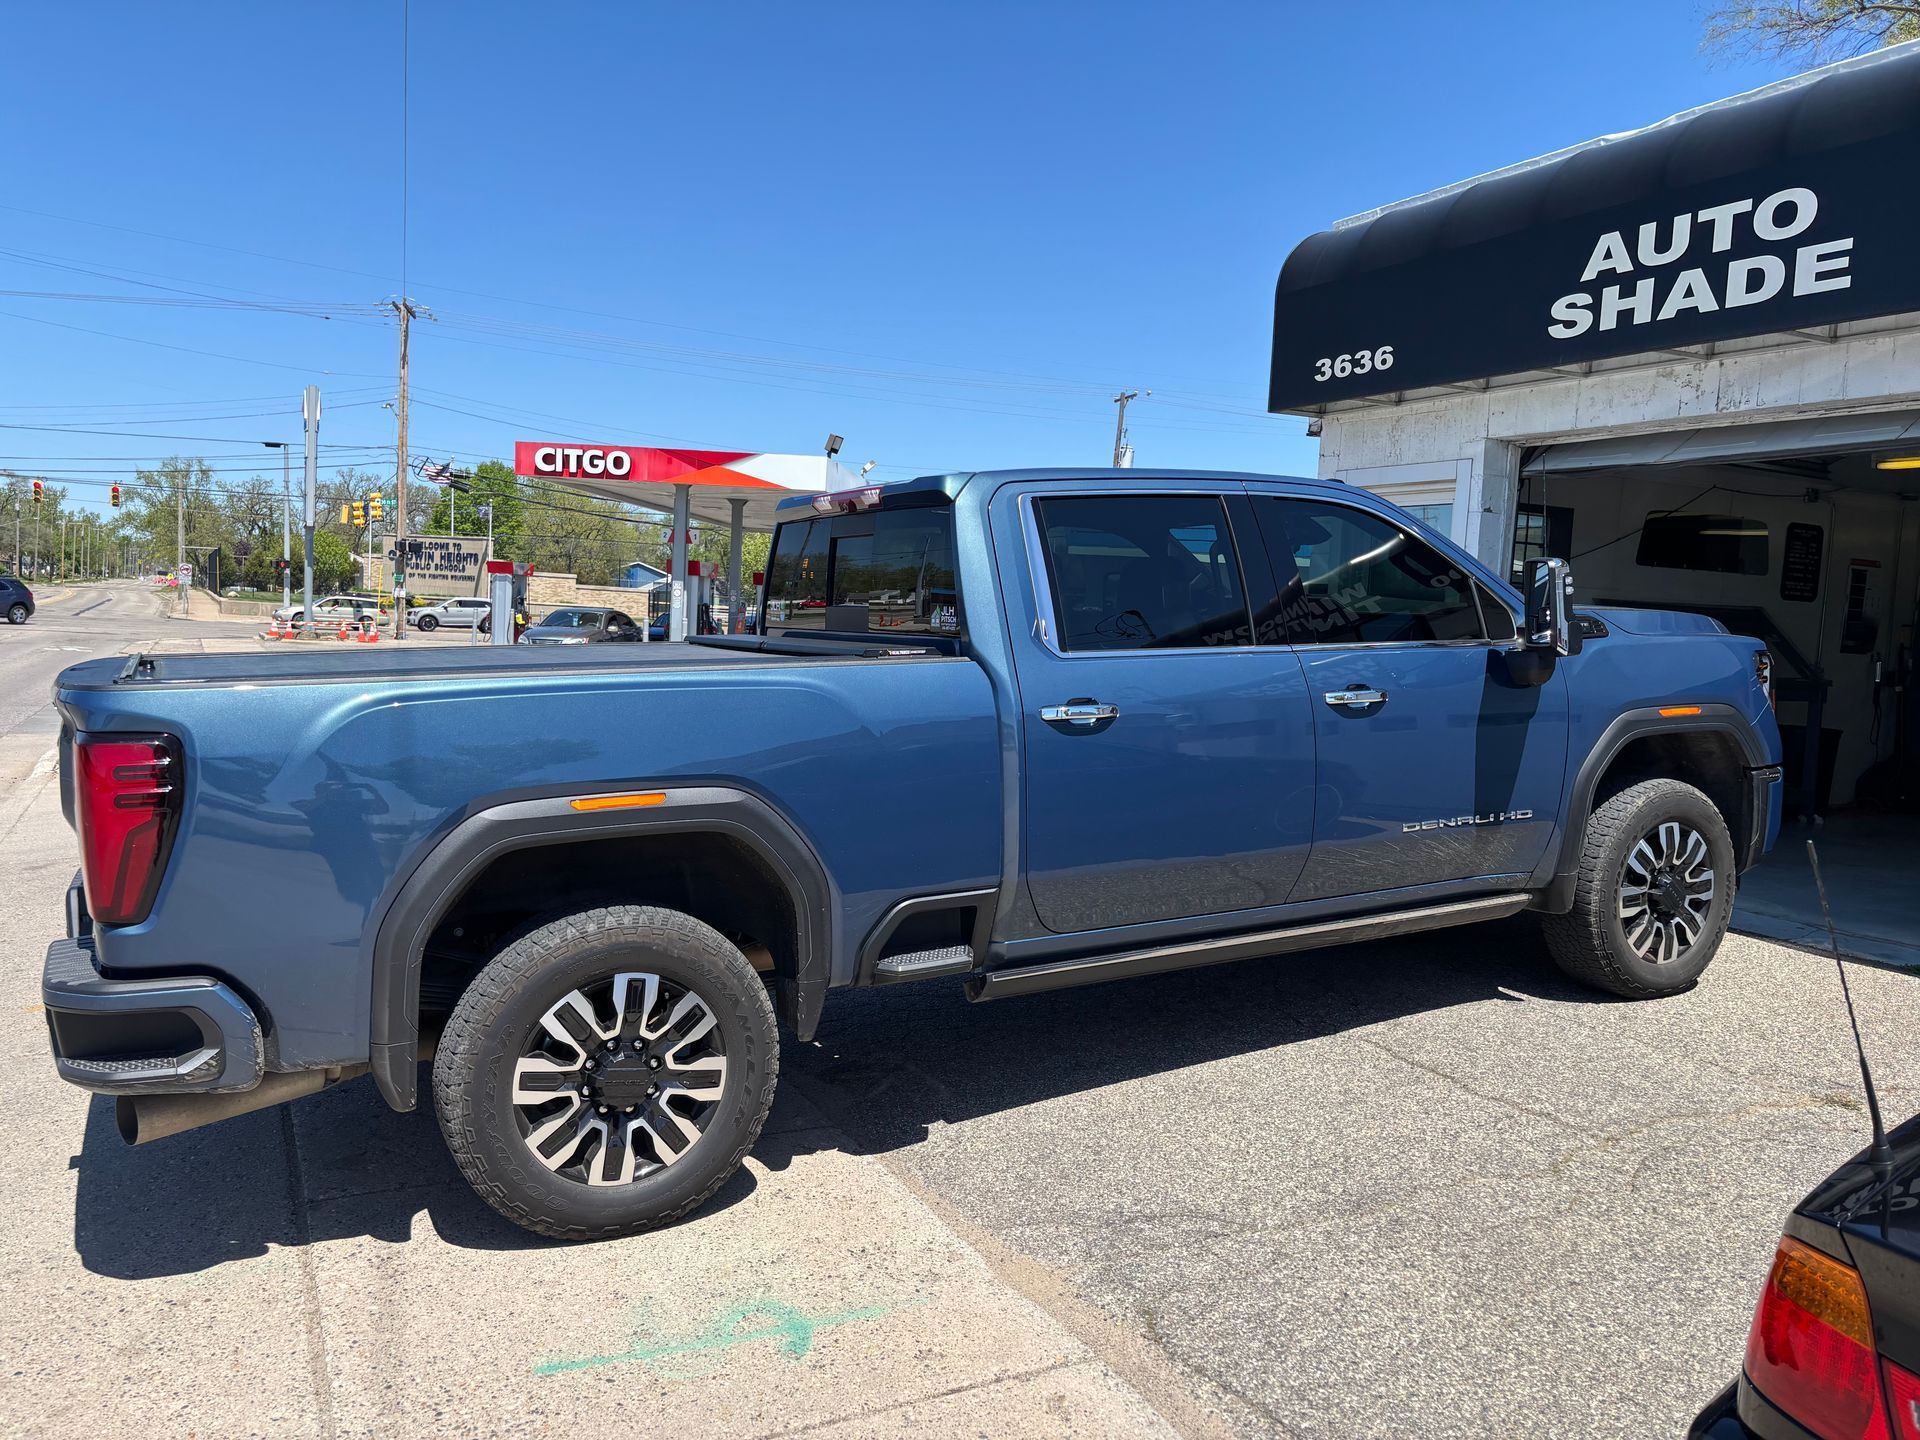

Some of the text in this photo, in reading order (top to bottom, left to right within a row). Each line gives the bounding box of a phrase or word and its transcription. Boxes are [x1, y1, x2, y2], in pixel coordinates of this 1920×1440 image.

[1580, 187, 1819, 282] AUTO
[1547, 237, 1854, 340] SHADE
[1314, 345, 1394, 382] 3636
[534, 446, 631, 476] CITGO
[440, 552, 479, 566] HEIGHTS
[452, 543, 462, 552] TO
[405, 561, 466, 573] PUBLIC SCHOOLS
[940, 605, 955, 616] JLH
[1402, 809, 1533, 832] DENALI HD
[687, 955, 758, 1130] WRANGLER
[478, 1022, 572, 1214] GOODYEAR
